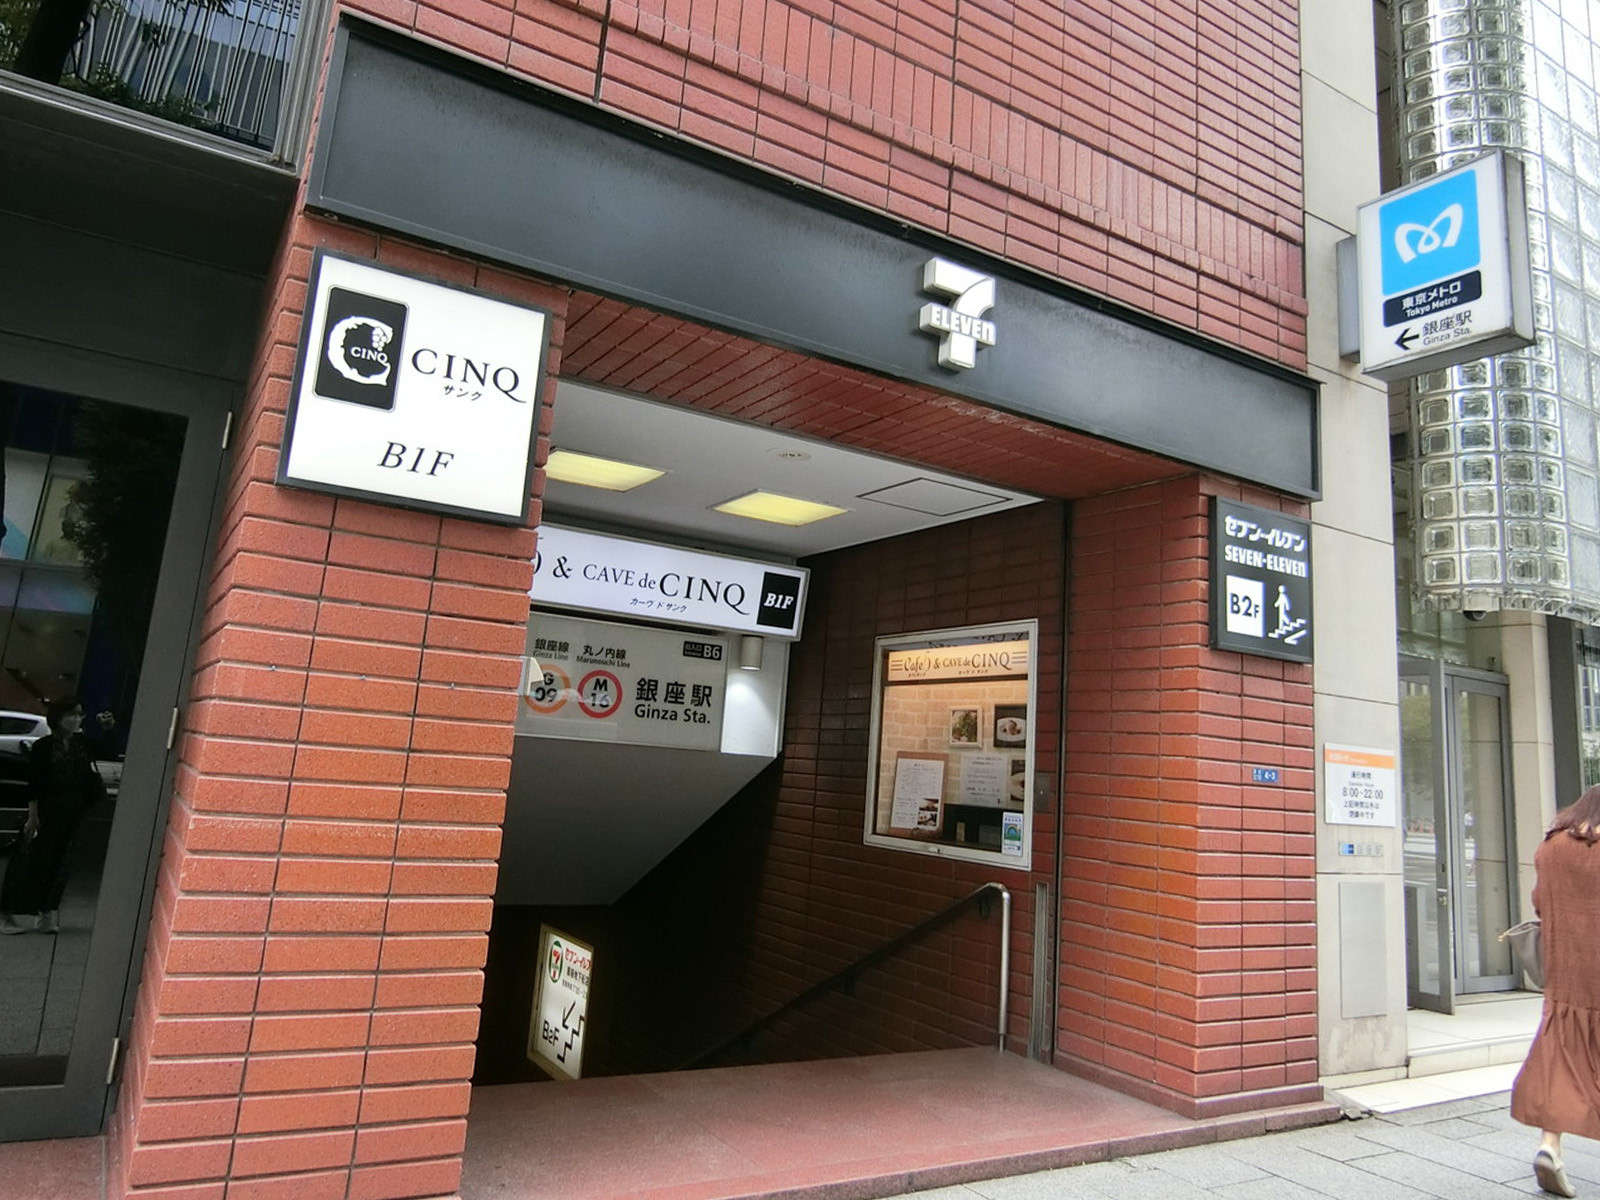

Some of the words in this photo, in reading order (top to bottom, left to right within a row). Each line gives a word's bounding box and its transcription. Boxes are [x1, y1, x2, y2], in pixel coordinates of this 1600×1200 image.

[1402, 281, 1461, 310] 東京メトロ
[1406, 305, 1431, 317] Tokyo
[1432, 296, 1458, 309] Metro
[1423, 310, 1472, 336] 銀座駅
[1423, 333, 1450, 346] Ginza
[350, 346, 388, 364] CINQ
[412, 348, 527, 404] CINQ
[444, 385, 482, 401] サンク
[583, 564, 635, 587] CAVE
[638, 576, 656, 590] de
[659, 572, 750, 615] CINQ
[764, 592, 794, 610] B1F
[1230, 593, 1260, 619] B2F
[533, 650, 553, 660] Ginza
[554, 652, 569, 660] Line
[535, 638, 570, 652] 銀座線
[582, 645, 627, 660] 丸ノ内線
[703, 645, 720, 659] B6
[576, 655, 616, 667] Marunouchi
[617, 659, 631, 668] Line
[971, 652, 1012, 671] CINQ
[543, 672, 554, 686] G
[593, 678, 608, 692] M
[636, 678, 712, 708] 銀座駅
[634, 704, 678, 722] Ginza
[683, 707, 711, 724] Sta.
